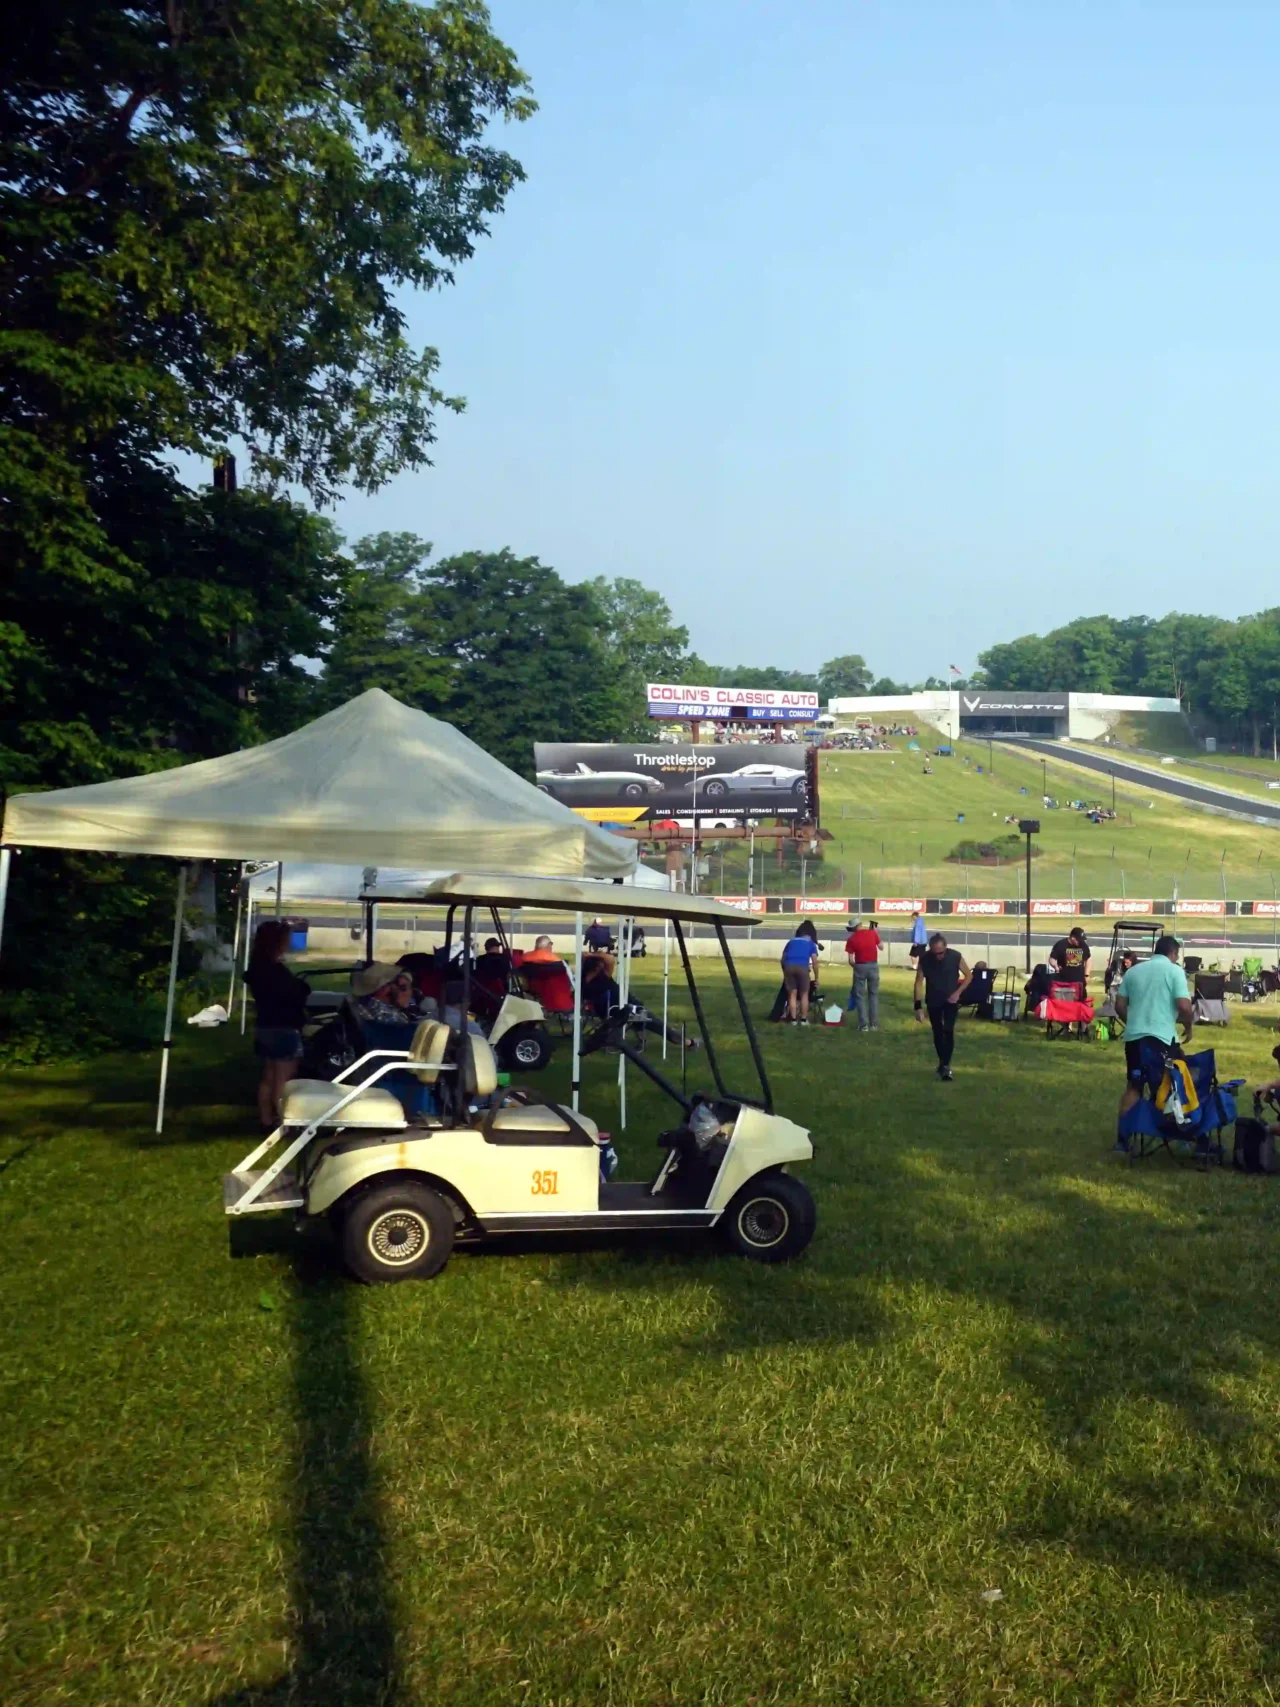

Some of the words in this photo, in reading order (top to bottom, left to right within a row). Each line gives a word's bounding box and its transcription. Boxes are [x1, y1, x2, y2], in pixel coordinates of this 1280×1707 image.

[650, 687, 710, 702] COLIN'S
[716, 691, 775, 705] CLASSIC
[781, 694, 817, 706] AUTO
[677, 704, 704, 716] SPEED
[705, 705, 731, 717] ZONE
[752, 709, 765, 717] BUY
[769, 709, 784, 717] SELL
[788, 710, 815, 718] CONSULT
[633, 753, 716, 769] Throttlestop
[800, 900, 845, 911] RaceQuip
[879, 900, 923, 911] RaceQuip
[957, 902, 1001, 913] RaceQuip
[1033, 903, 1076, 914] RaceQuip
[1108, 902, 1149, 913] RaceQuip
[530, 1170, 559, 1196] 351
